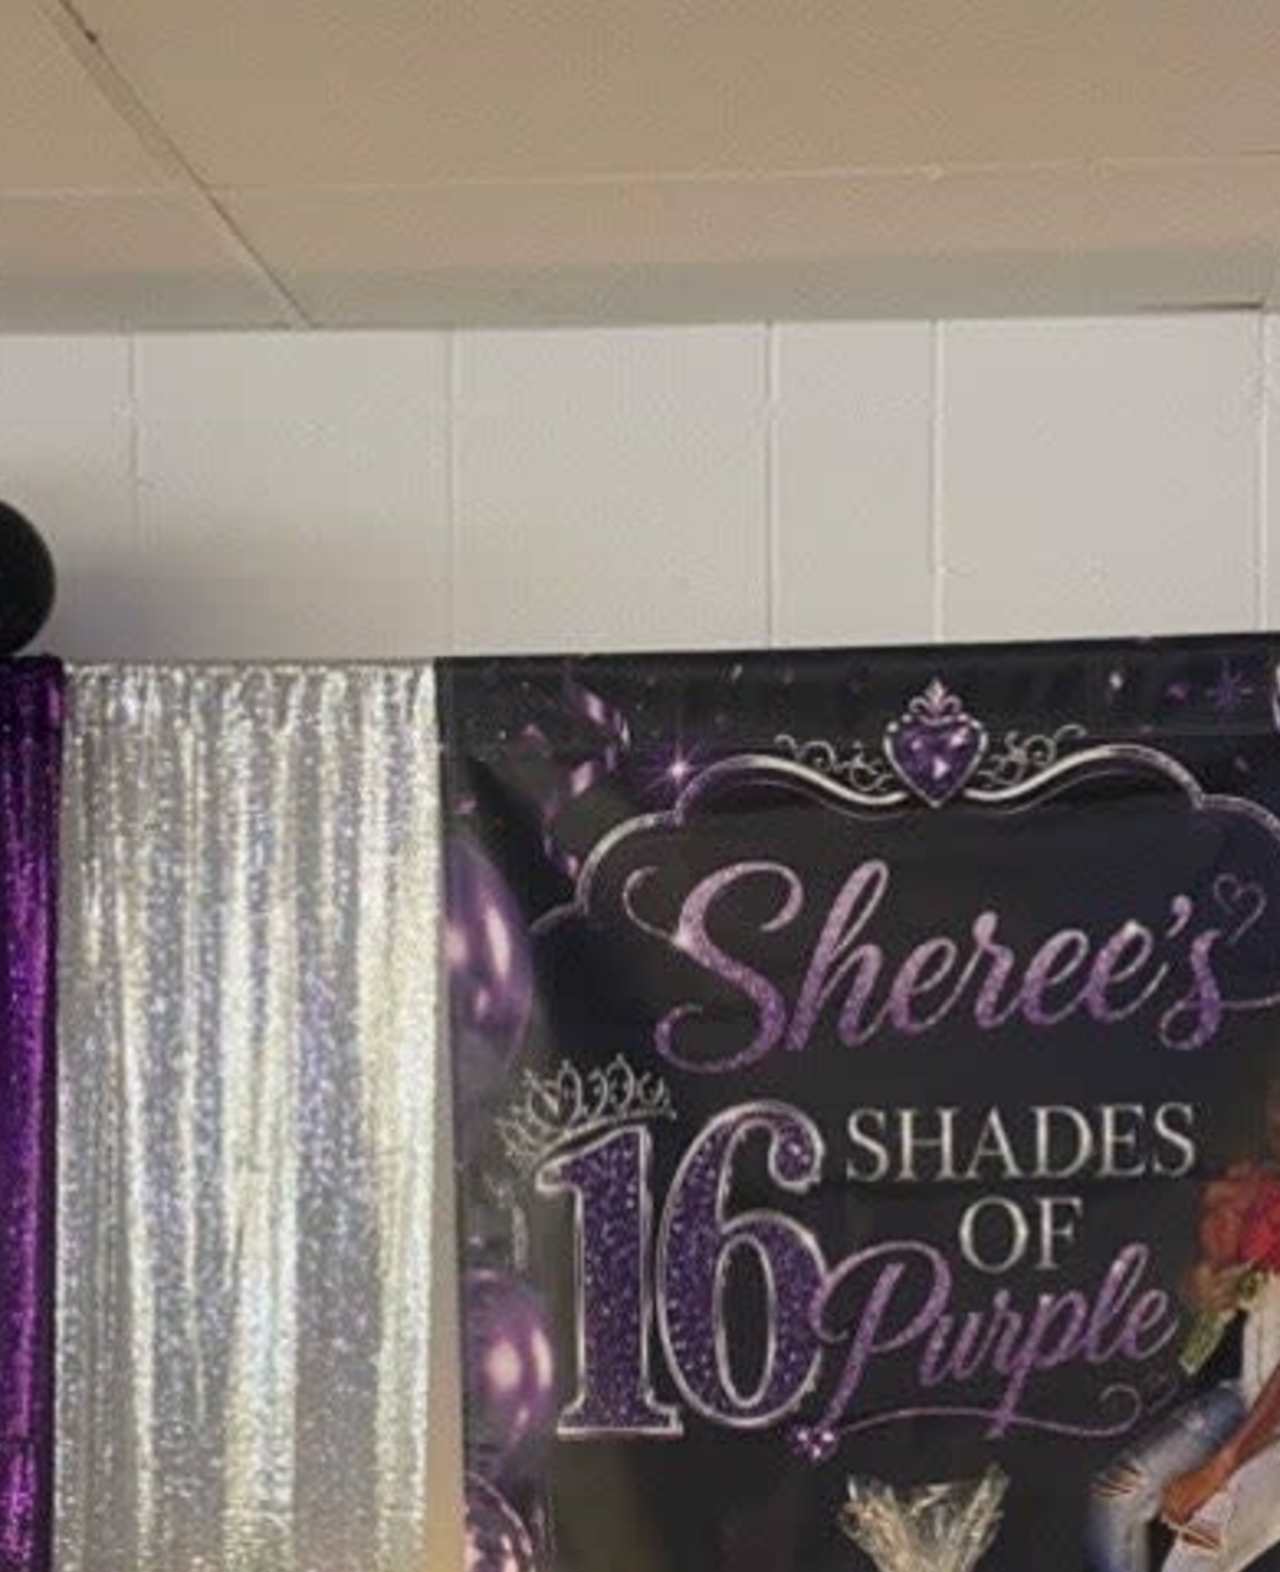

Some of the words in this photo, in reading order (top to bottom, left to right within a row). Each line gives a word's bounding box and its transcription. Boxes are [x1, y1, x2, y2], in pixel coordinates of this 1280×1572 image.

[845, 1102, 1196, 1184] SHADES
[535, 1099, 826, 1437] 16
[958, 1196, 1082, 1274] OF
[810, 1242, 1184, 1439] Purple
